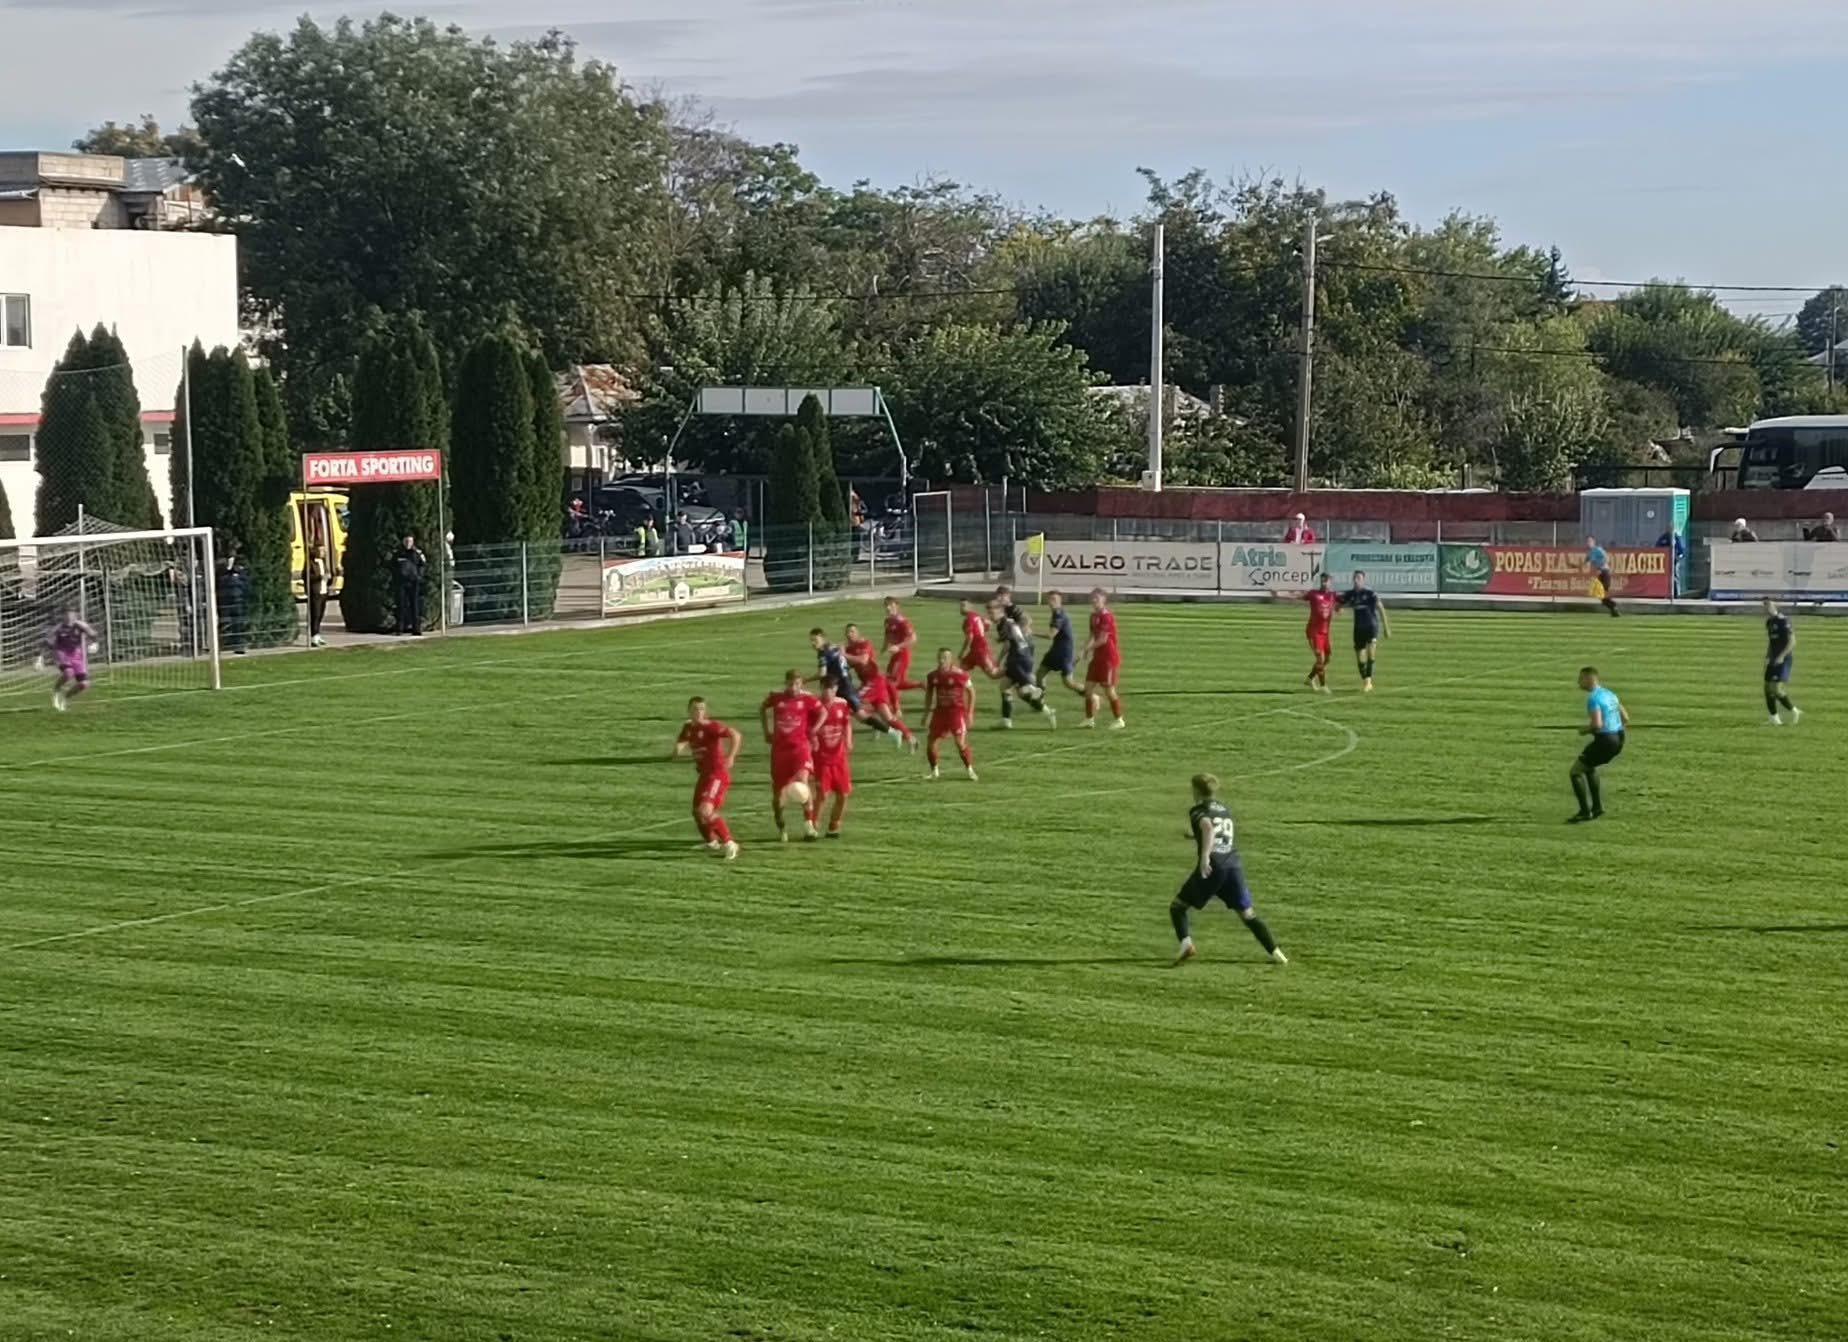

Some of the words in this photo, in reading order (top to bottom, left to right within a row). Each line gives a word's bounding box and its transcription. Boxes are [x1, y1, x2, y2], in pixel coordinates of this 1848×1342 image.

[309, 459, 358, 478] FORTA
[361, 455, 434, 476] SPORTING
[1047, 554, 1126, 569] VALRO
[1132, 556, 1213, 572] TRADE
[1495, 552, 1542, 573] POPAS
[1212, 817, 1234, 848] 29
